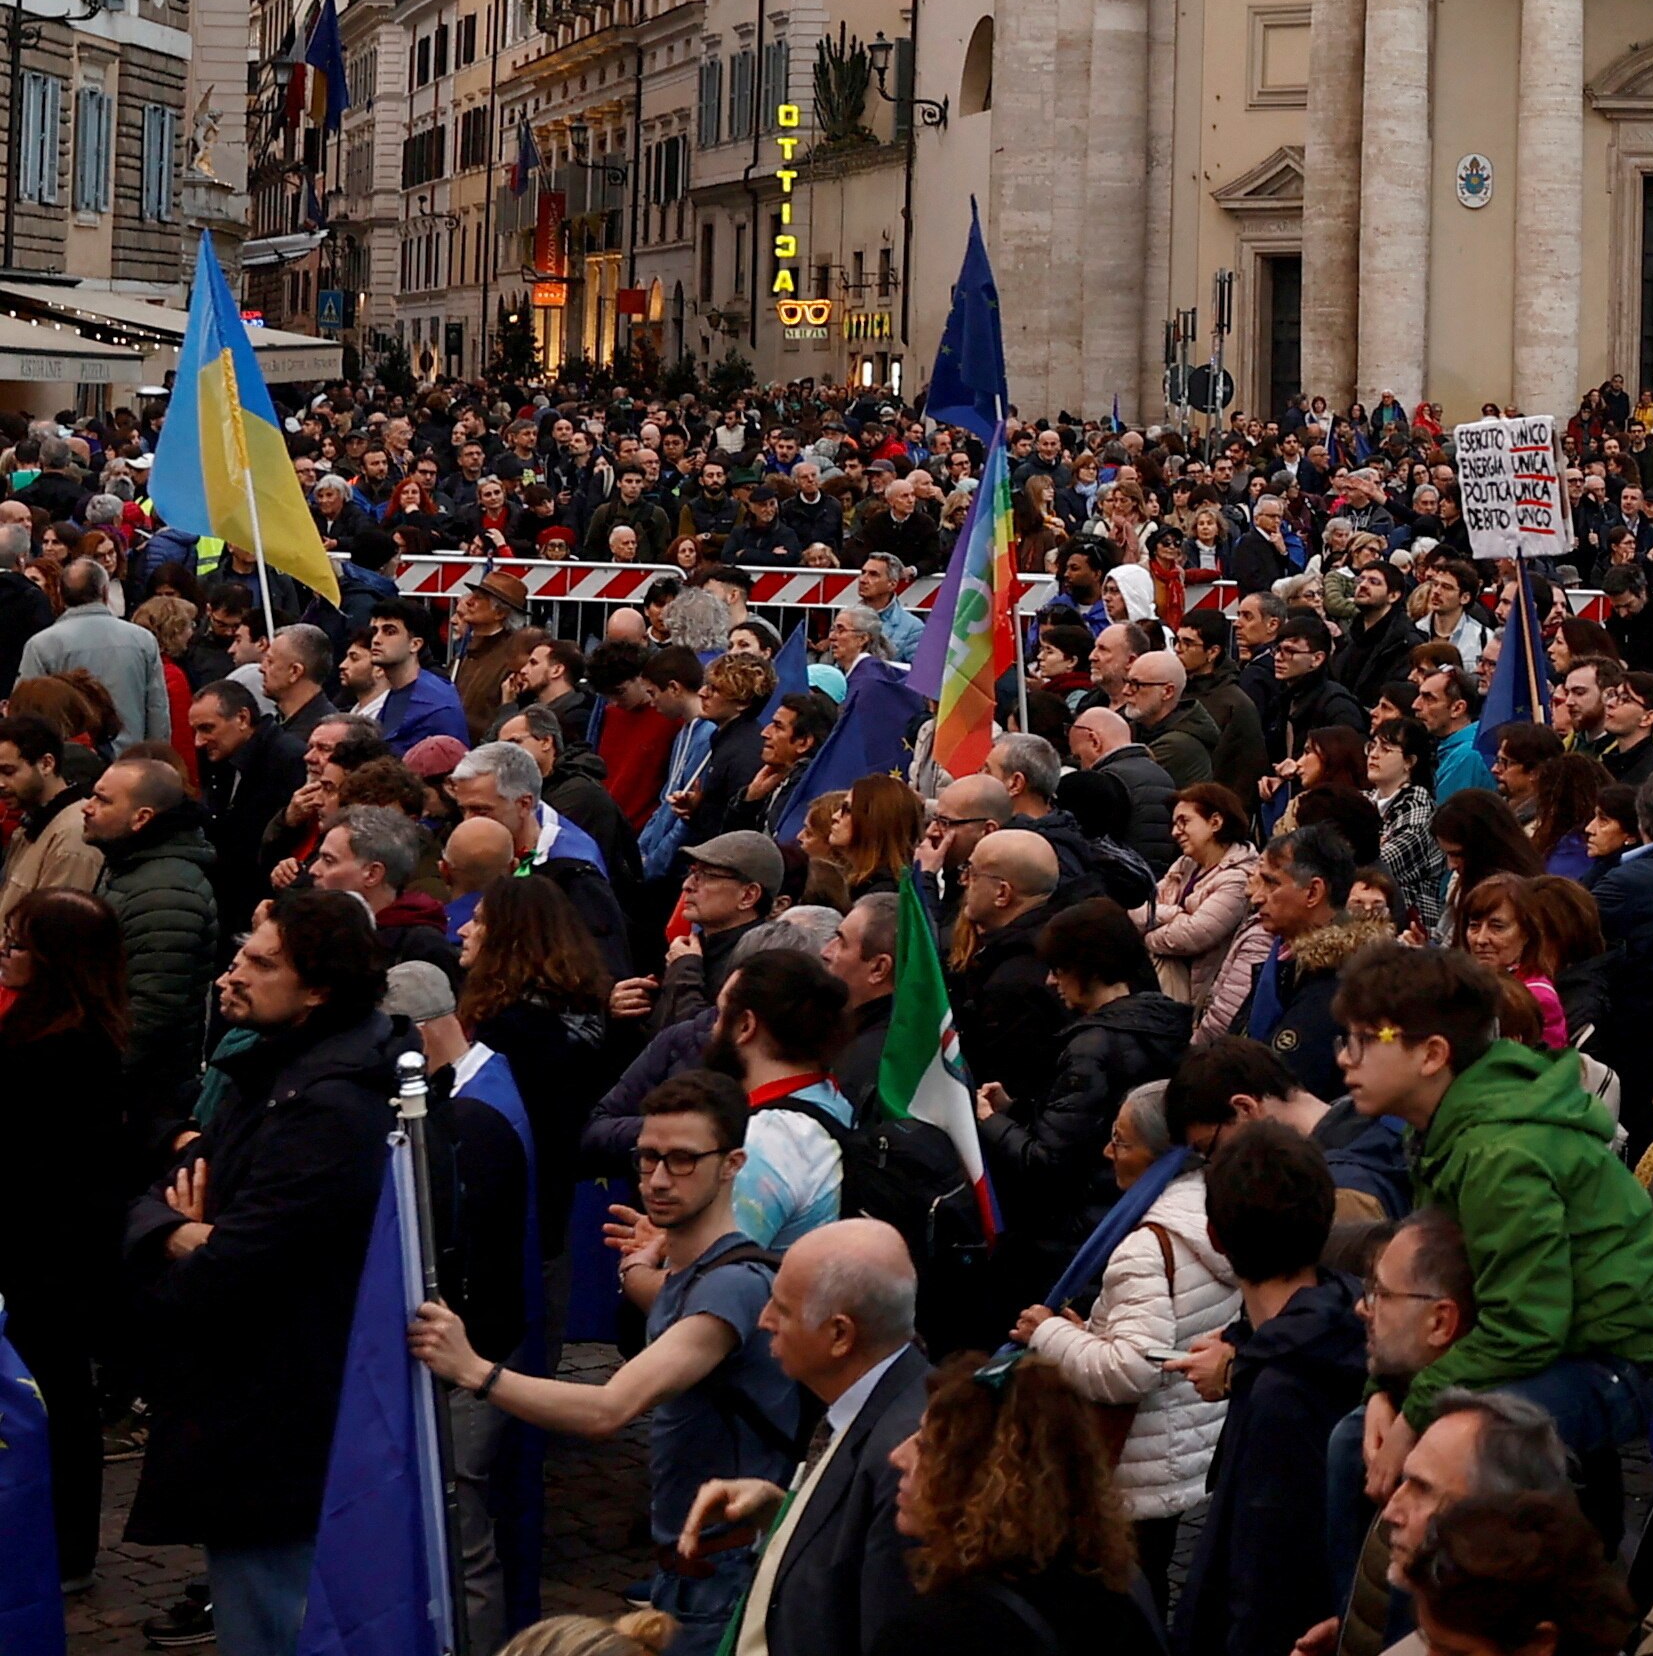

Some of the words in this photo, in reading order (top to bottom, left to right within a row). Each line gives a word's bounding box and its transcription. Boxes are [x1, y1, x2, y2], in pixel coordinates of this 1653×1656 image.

[843, 312, 891, 340] OTTICA
[1459, 428, 1505, 454] ESERCITO
[1510, 421, 1548, 447] UNICO
[1461, 455, 1505, 480] ENERGIA
[1511, 452, 1550, 475] UNICA
[1464, 481, 1513, 506] POLITICA
[1512, 480, 1551, 502] UNICA
[1467, 507, 1511, 531] DEBITO
[1515, 506, 1551, 528] UNICO
